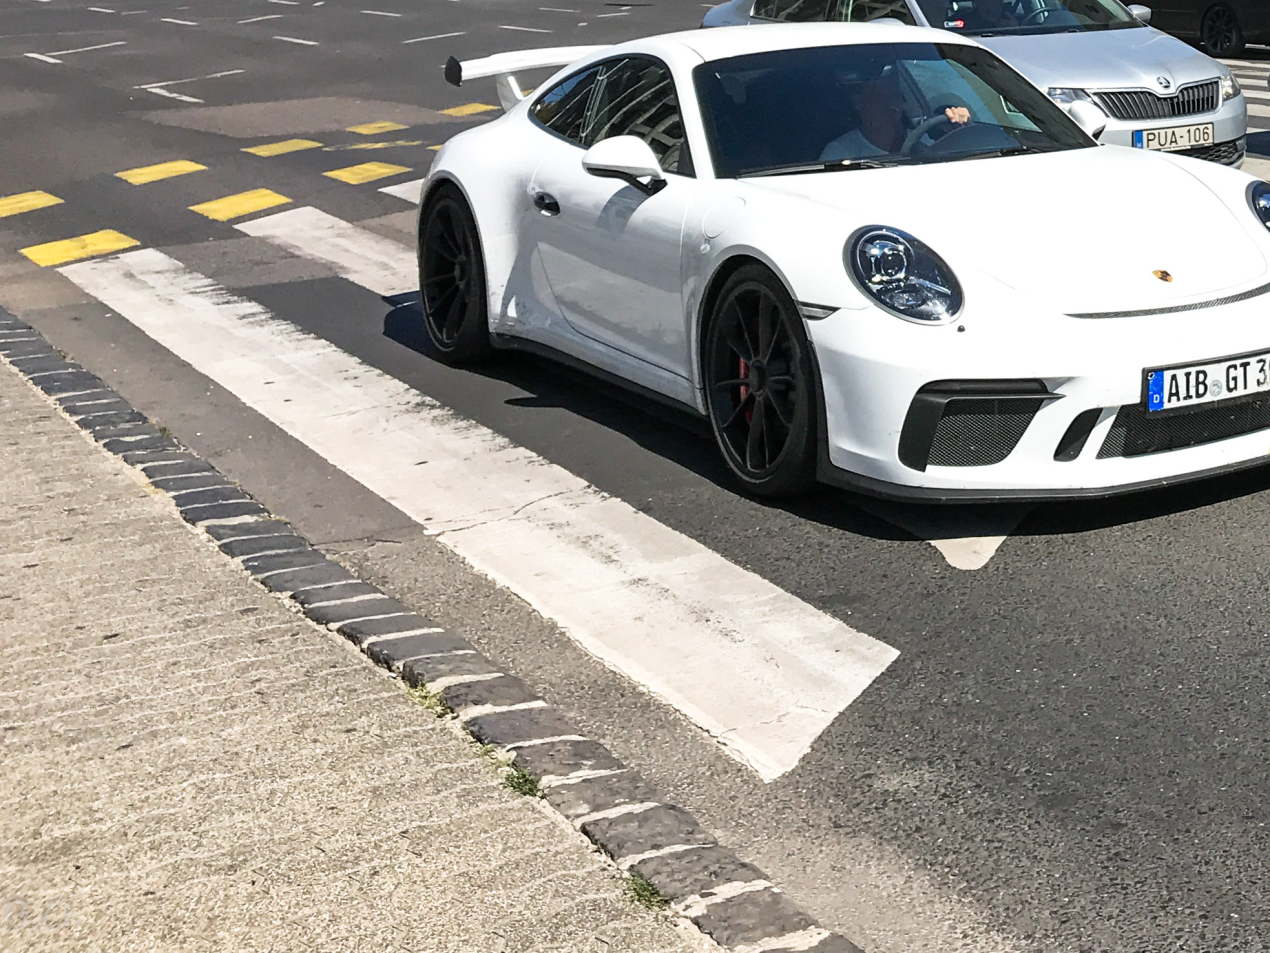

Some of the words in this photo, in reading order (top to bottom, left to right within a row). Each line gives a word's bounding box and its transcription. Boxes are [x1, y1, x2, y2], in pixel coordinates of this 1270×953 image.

[1146, 126, 1210, 149] PUA-106
[1167, 369, 1209, 404] AIB
[1225, 361, 1251, 393] GT
[1153, 394, 1160, 404] D
